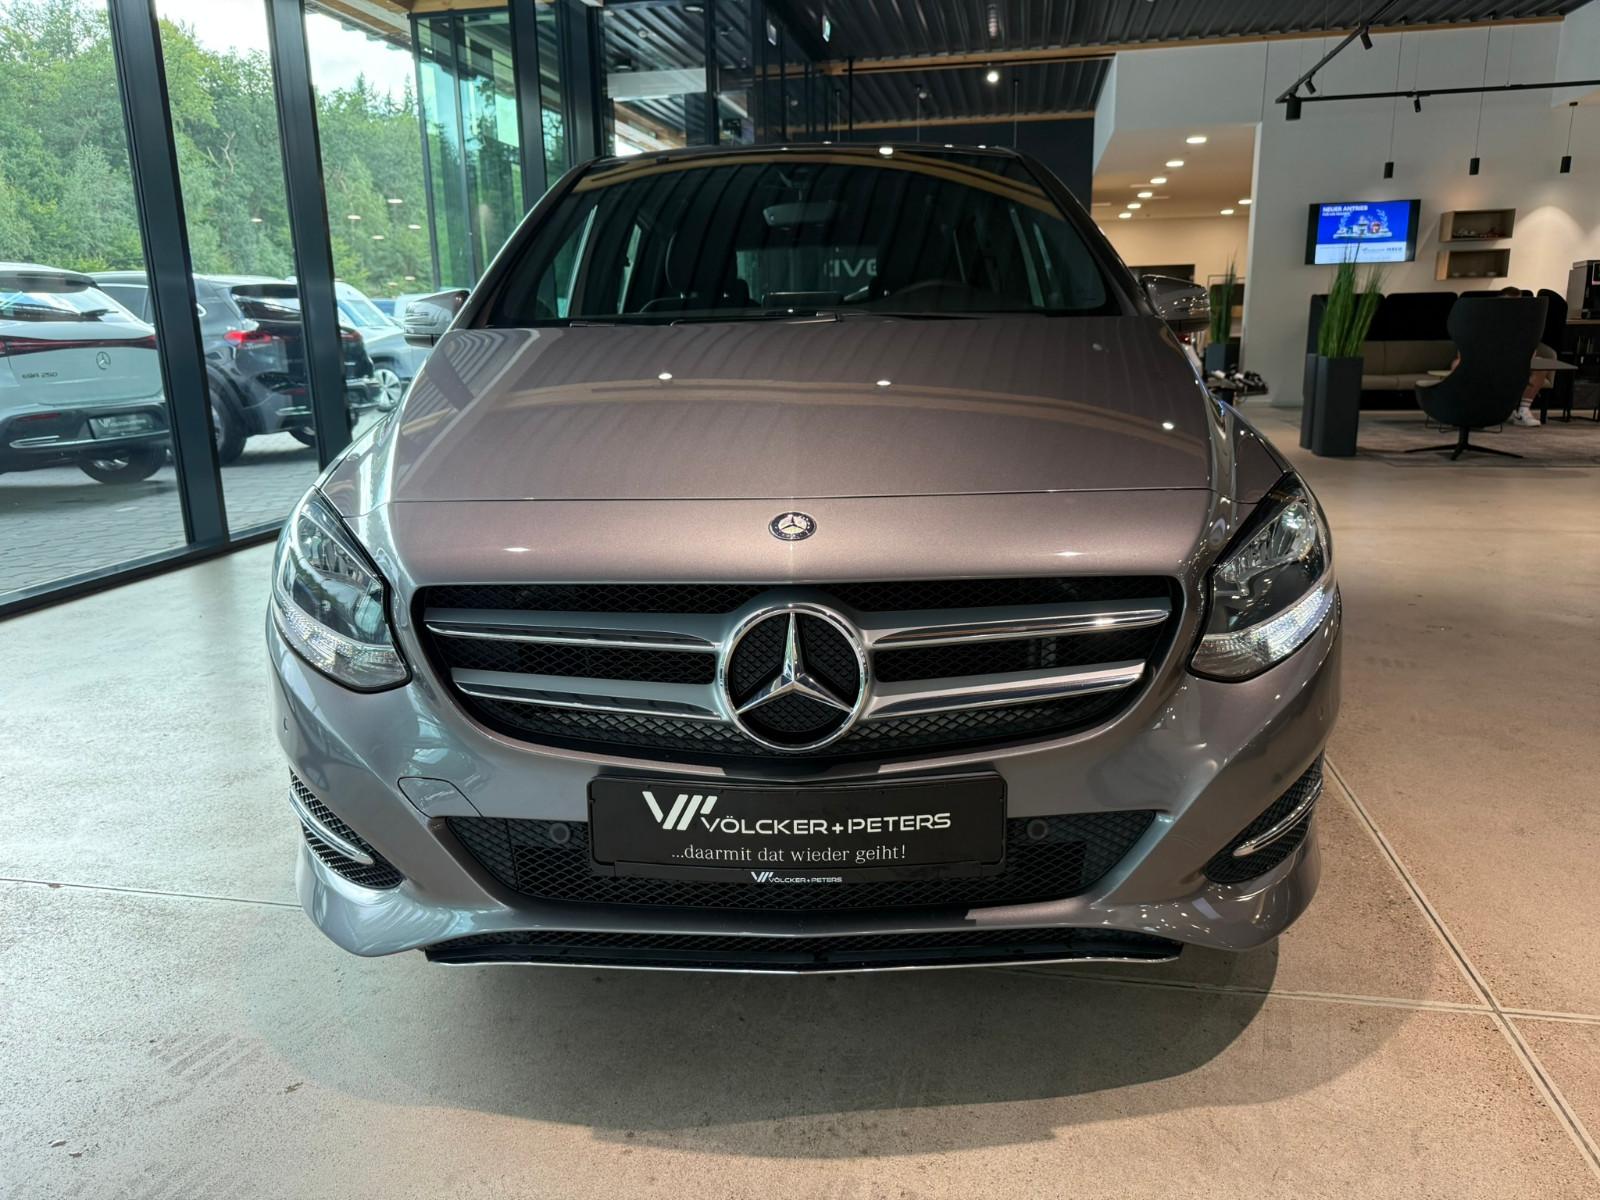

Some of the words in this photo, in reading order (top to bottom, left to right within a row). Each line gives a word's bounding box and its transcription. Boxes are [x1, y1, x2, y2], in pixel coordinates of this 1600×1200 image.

[671, 845, 753, 861] ...daarmit
[756, 847, 785, 862] dat
[790, 847, 851, 862] wieder
[855, 844, 906, 864] geiht!
